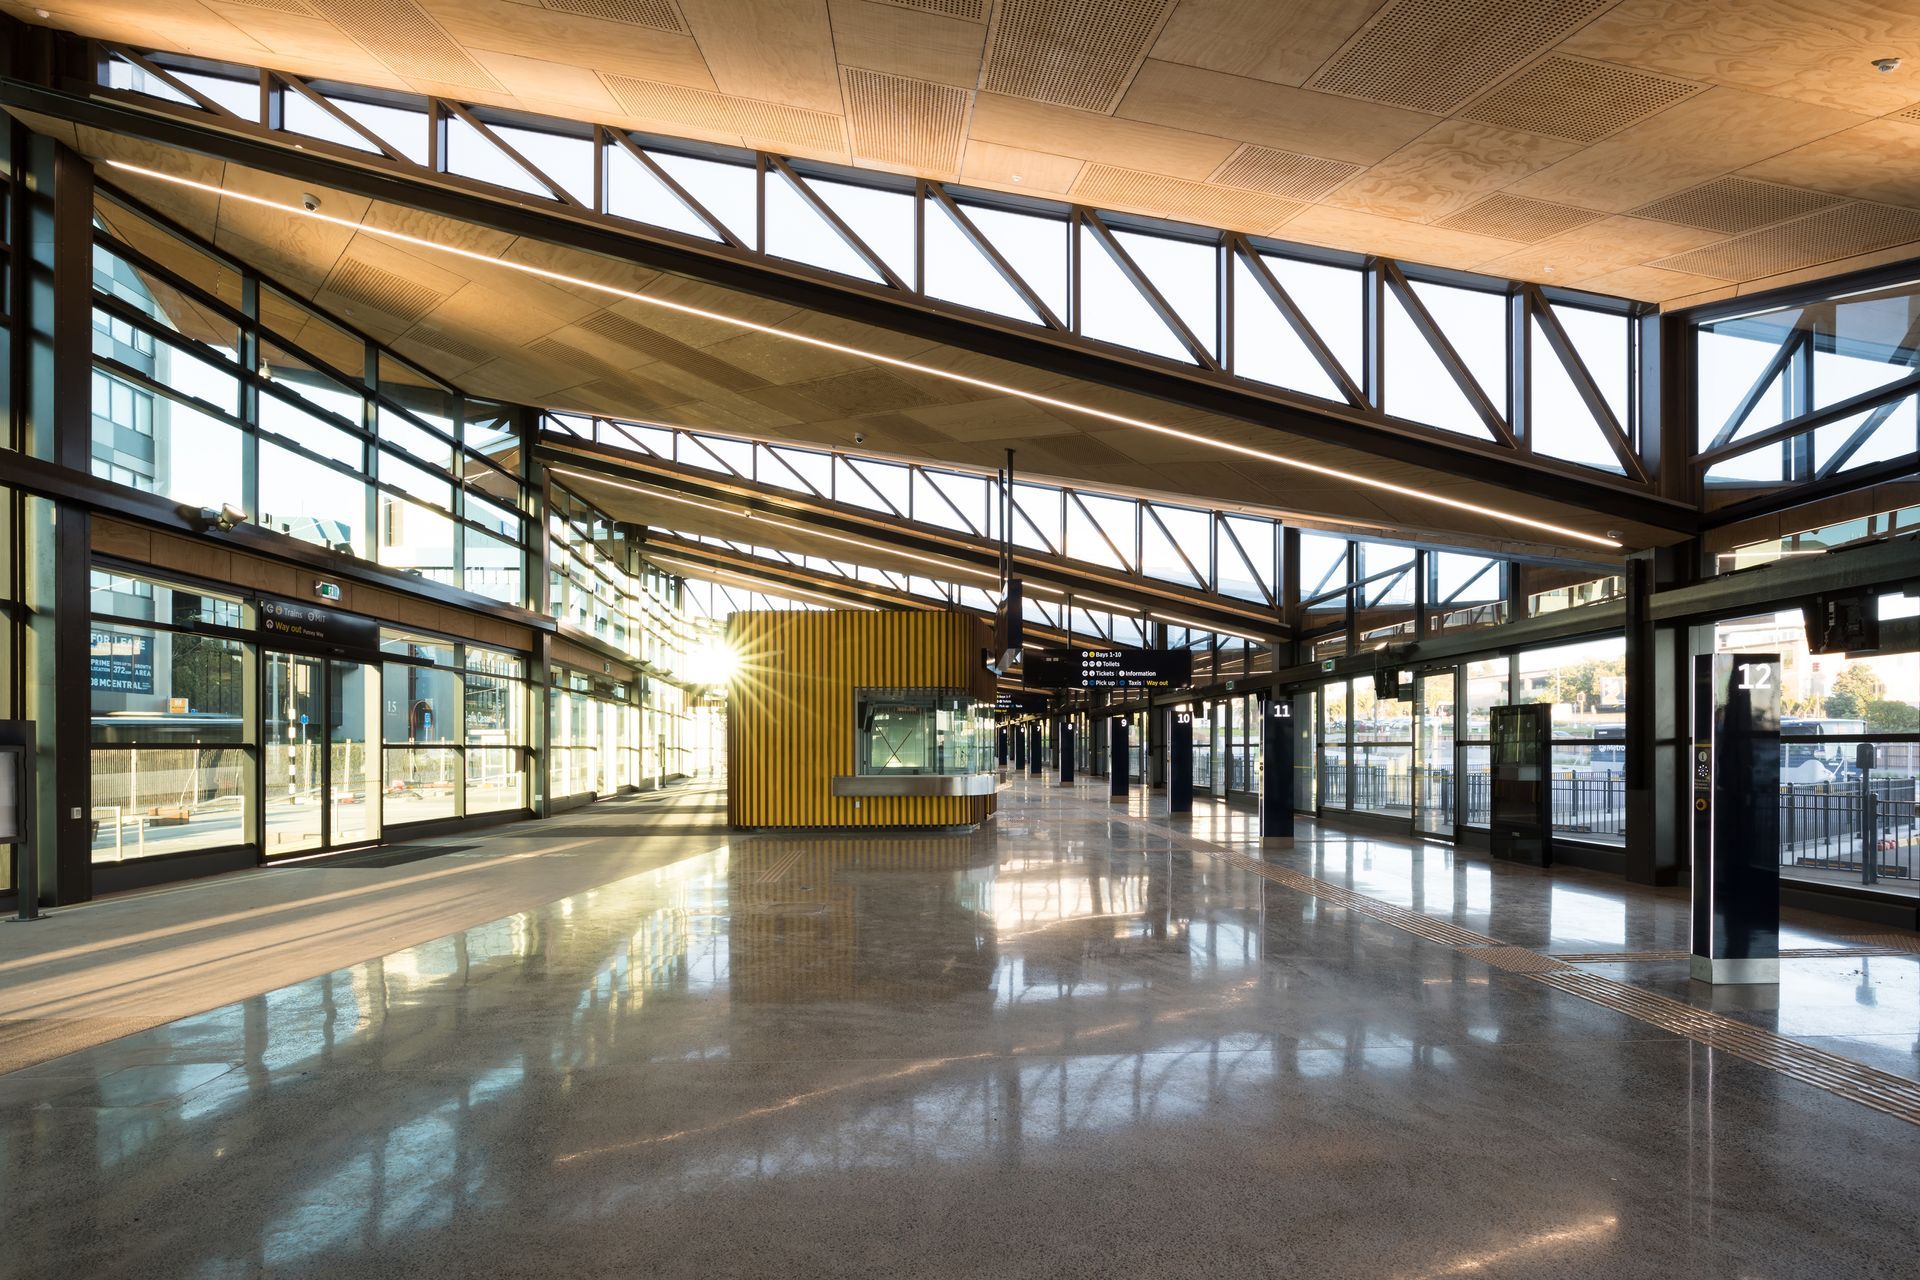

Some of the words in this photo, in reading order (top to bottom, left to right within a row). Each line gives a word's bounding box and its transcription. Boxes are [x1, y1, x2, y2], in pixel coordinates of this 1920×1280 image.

[284, 608, 303, 619] Trains
[275, 621, 289, 632] Way
[291, 626, 302, 634] out
[91, 633, 110, 644] FOR
[91, 659, 110, 667] PRIME
[113, 666, 125, 674] 372
[1738, 663, 1772, 690] 12
[387, 700, 397, 713] 15
[1274, 705, 1290, 717] 11
[1121, 719, 1127, 727] 9
[1177, 714, 1190, 724] 10
